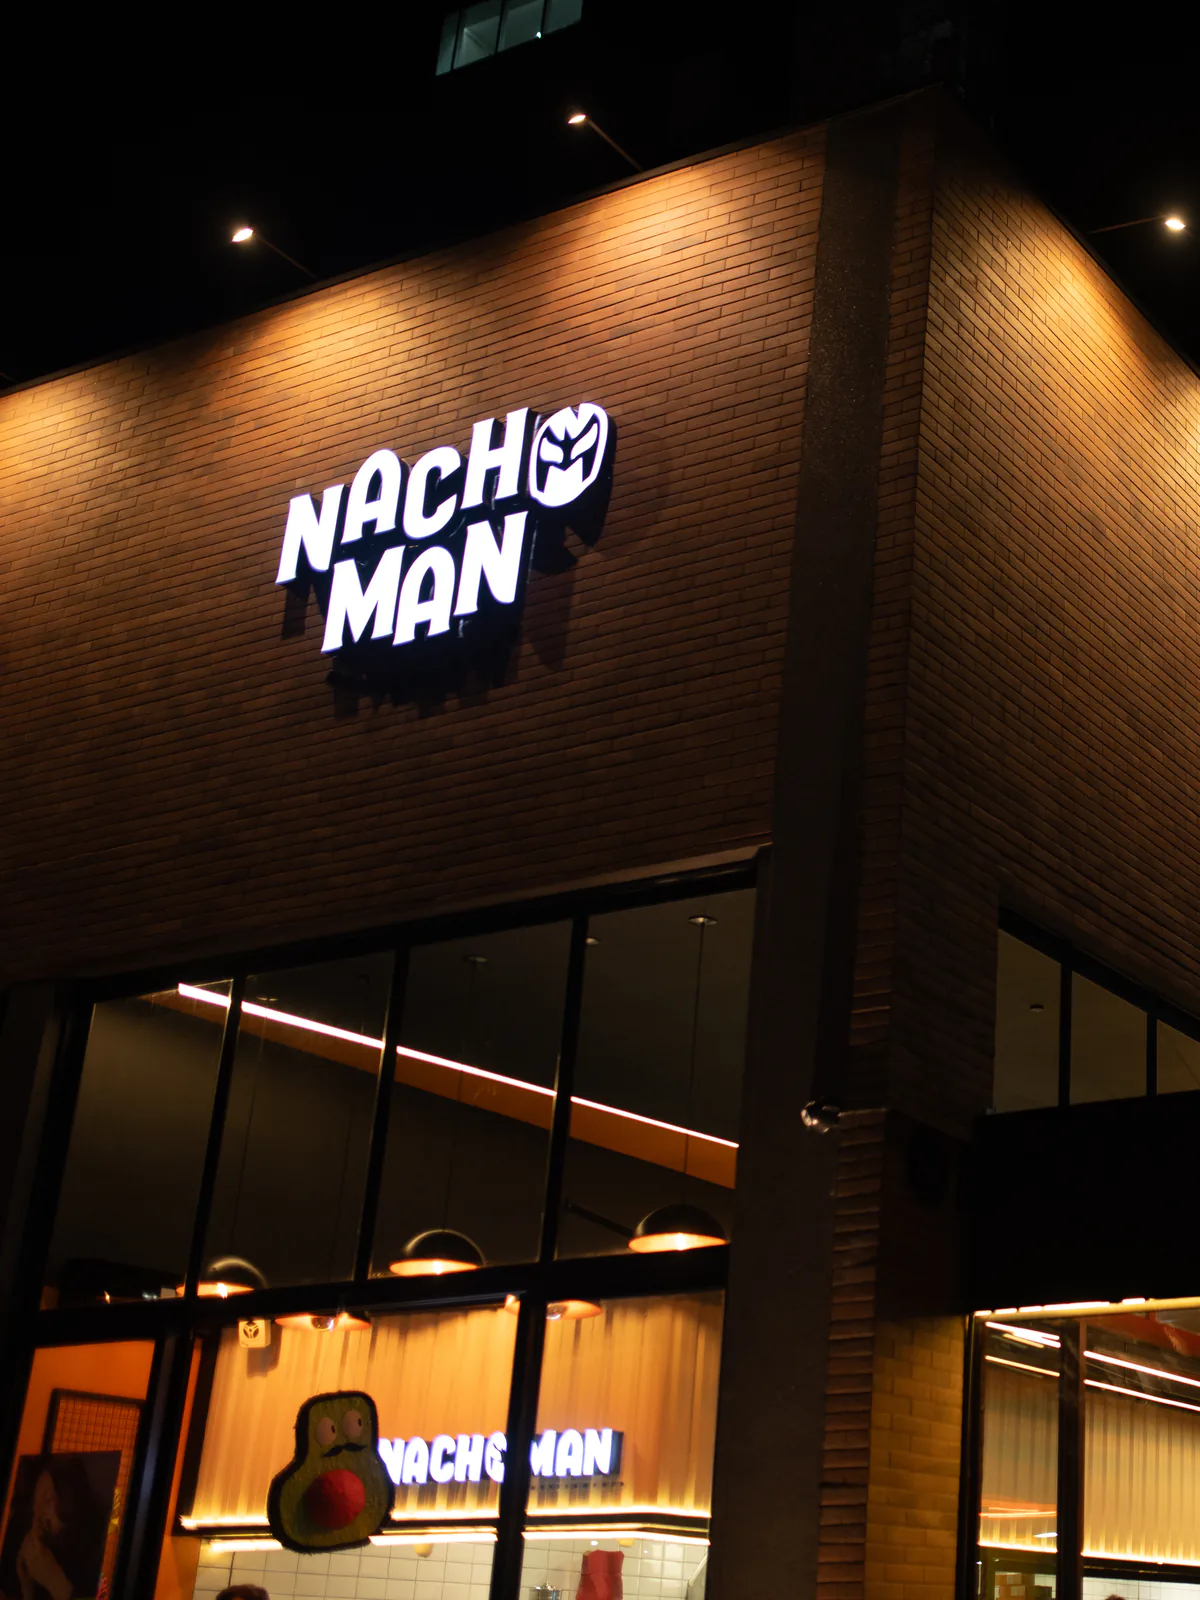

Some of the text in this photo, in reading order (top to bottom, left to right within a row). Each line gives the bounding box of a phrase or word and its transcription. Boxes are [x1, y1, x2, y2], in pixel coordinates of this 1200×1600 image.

[275, 402, 609, 585] NACHO
[320, 511, 529, 653] MAN
[530, 1428, 613, 1477] MAN
